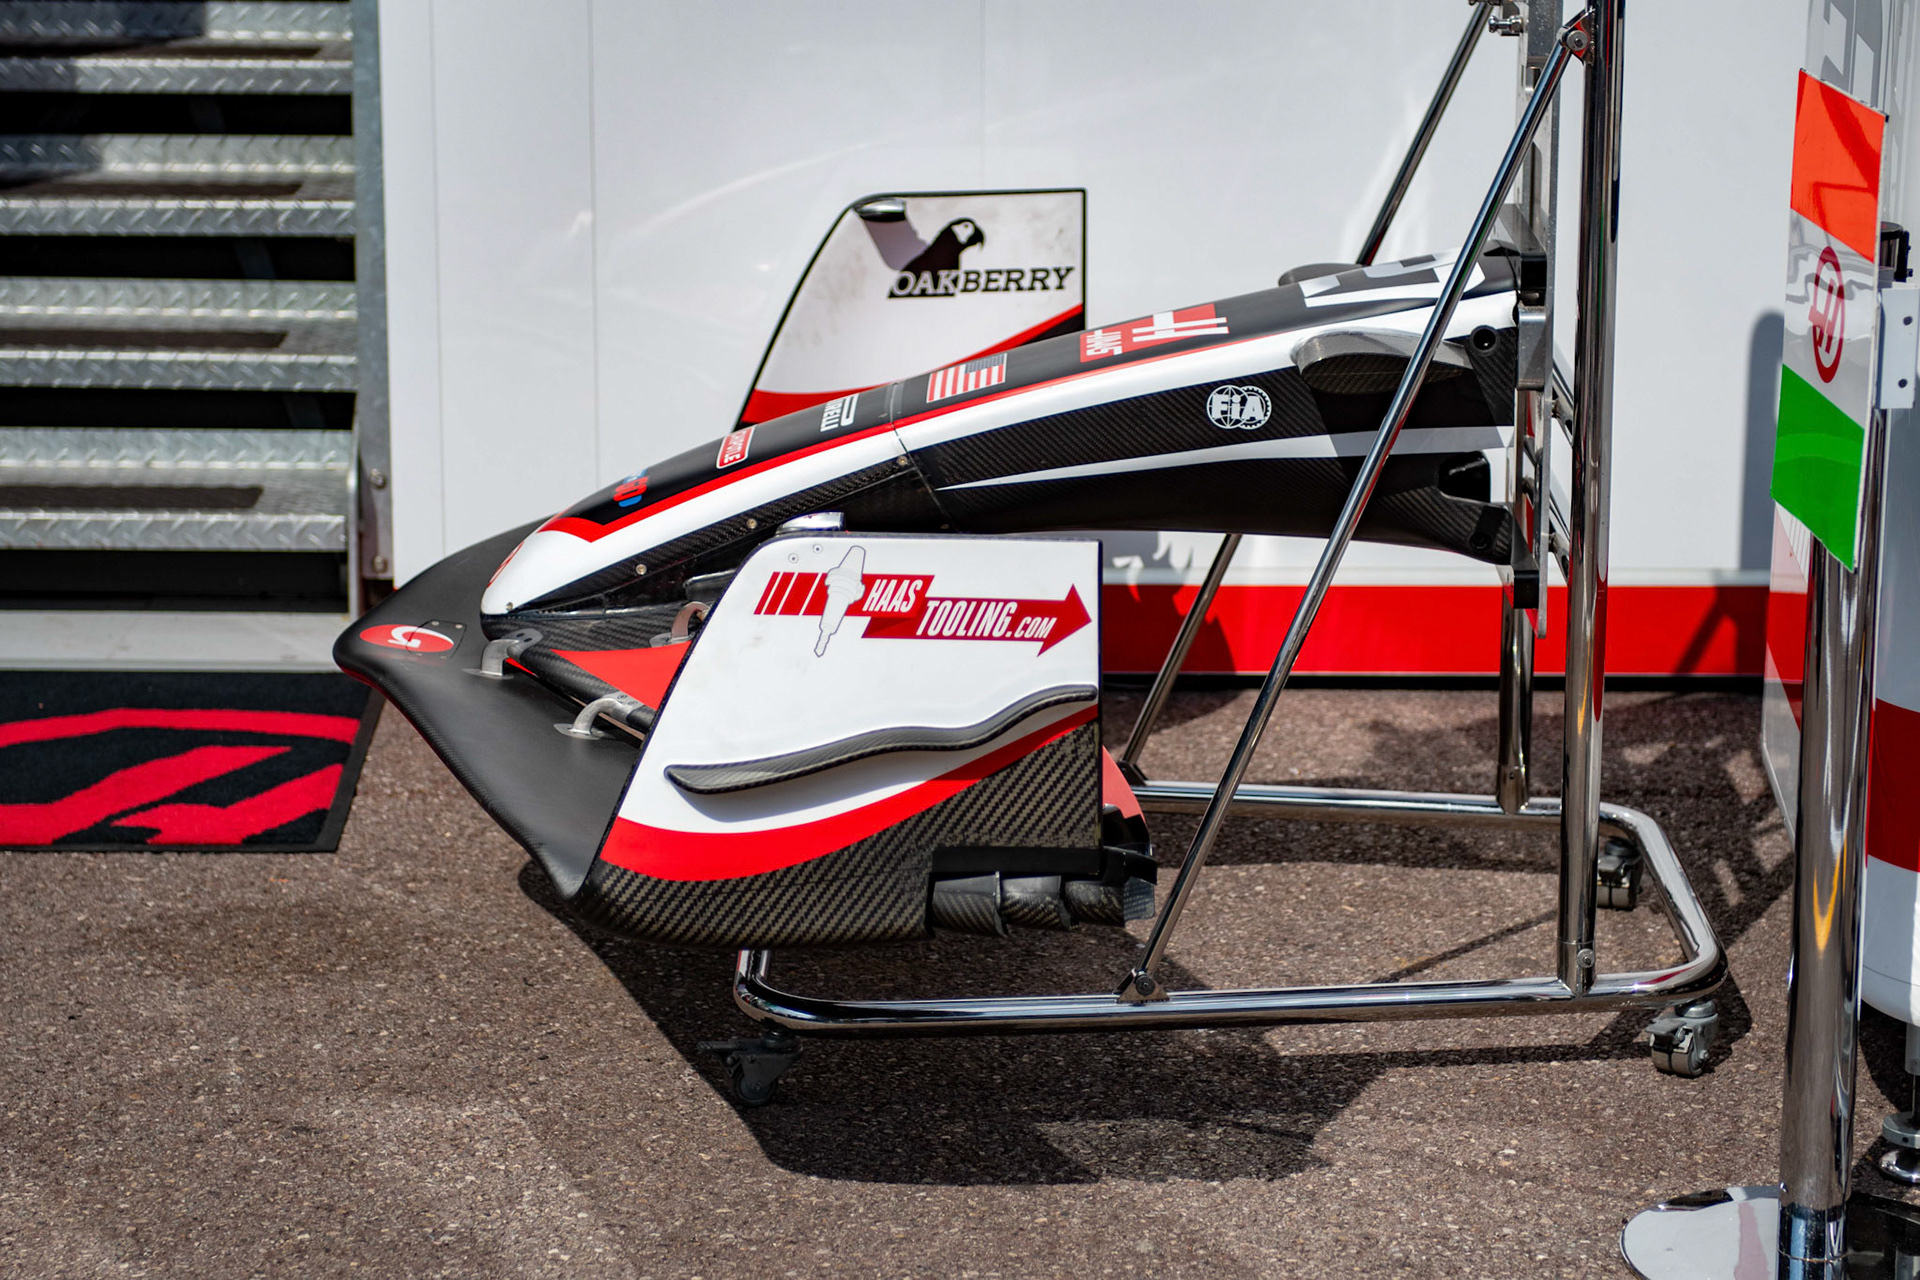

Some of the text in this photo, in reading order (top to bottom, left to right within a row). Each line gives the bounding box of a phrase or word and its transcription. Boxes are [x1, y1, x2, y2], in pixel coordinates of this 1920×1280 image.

[893, 266, 1075, 296] OAKBERRY
[862, 579, 1057, 639] HAAS TOOLING.COM
